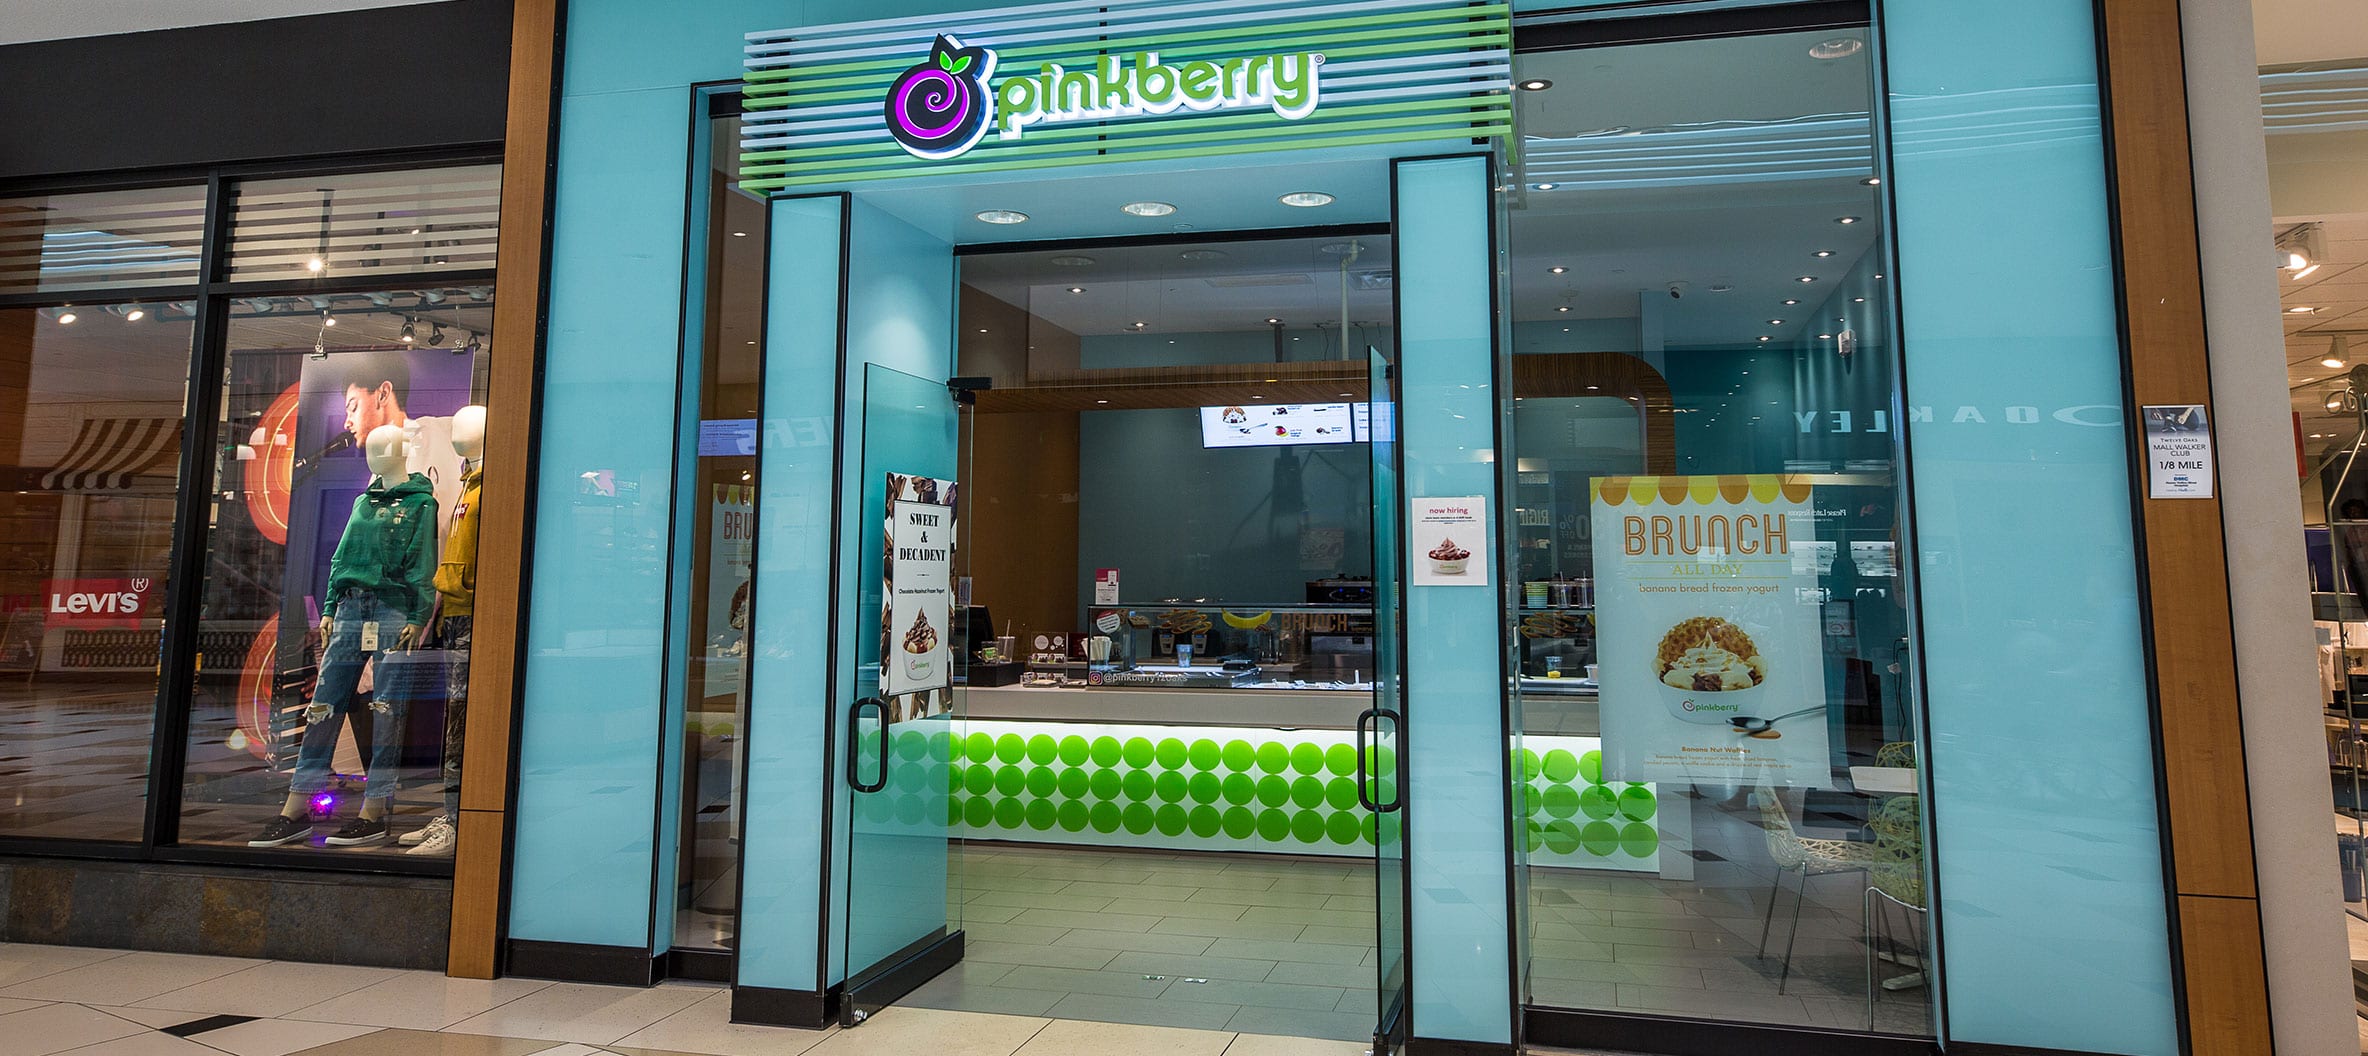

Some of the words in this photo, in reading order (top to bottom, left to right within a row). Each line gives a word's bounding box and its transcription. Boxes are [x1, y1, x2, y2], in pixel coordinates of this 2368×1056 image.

[998, 51, 1312, 136] pinkberry
[2175, 443, 2207, 451] WALKER
[2159, 460, 2175, 470] 1/8
[2178, 460, 2203, 470] MILE
[1446, 506, 1469, 515] hiring
[909, 511, 940, 528] SWEET
[920, 531, 929, 544] &
[1623, 513, 1789, 556] BRUNCH
[899, 547, 947, 563] DECADENT
[1671, 563, 1705, 576] ALL
[1710, 563, 1744, 576] DAY
[1639, 582, 1677, 593] banana
[1679, 582, 1709, 593] bread
[1712, 582, 1744, 593] frozen
[1746, 582, 1780, 594] yogurt
[1280, 613, 1349, 632] BRUNCH
[1694, 702, 1740, 713] pinkberry
[1681, 745, 1709, 753] Banana
[1710, 745, 1723, 753] Nut
[1724, 746, 1751, 754] Waffes
